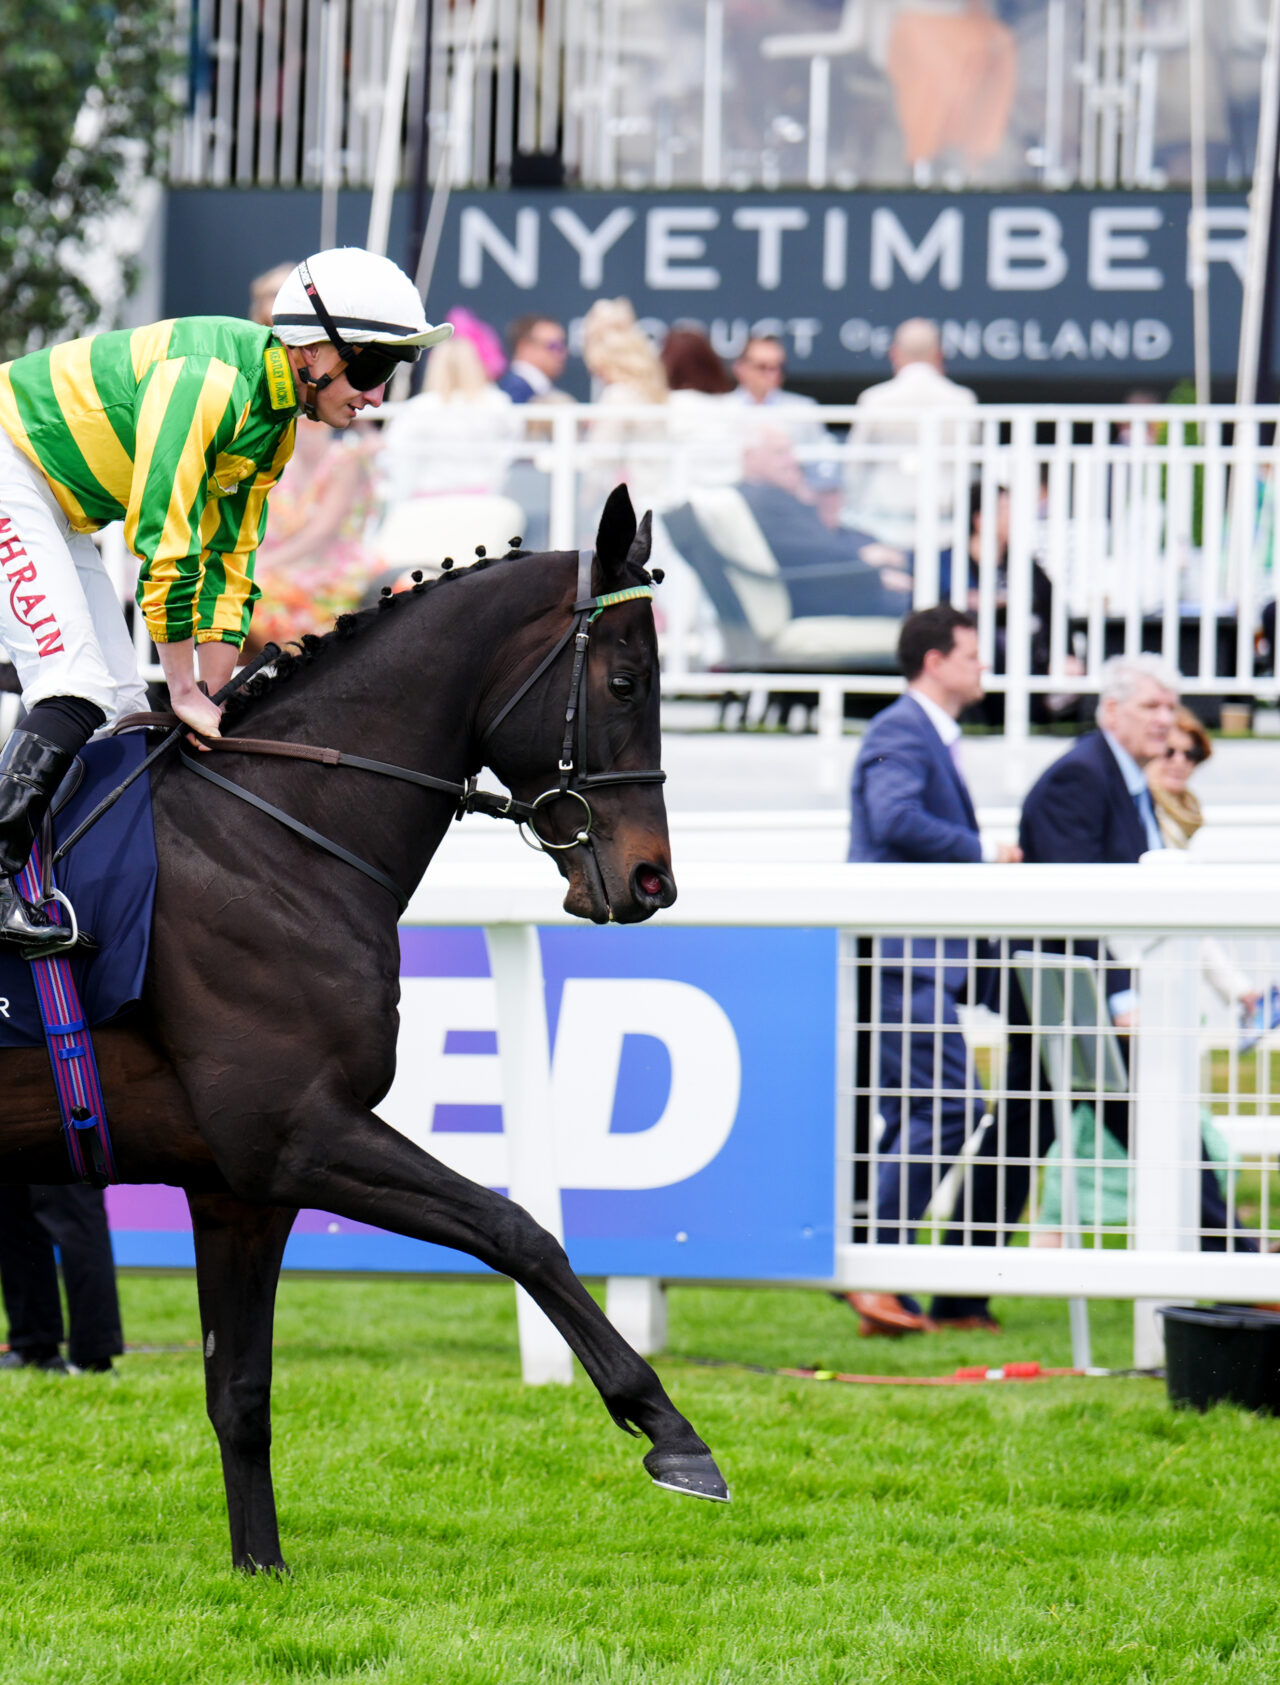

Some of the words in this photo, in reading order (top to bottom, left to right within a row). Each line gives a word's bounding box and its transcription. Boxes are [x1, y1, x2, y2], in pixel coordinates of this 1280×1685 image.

[458, 206, 1255, 290] NYETIMBER
[927, 317, 1173, 360] NGLAND
[270, 350, 285, 379] KEATLEY
[275, 381, 289, 406] RACING
